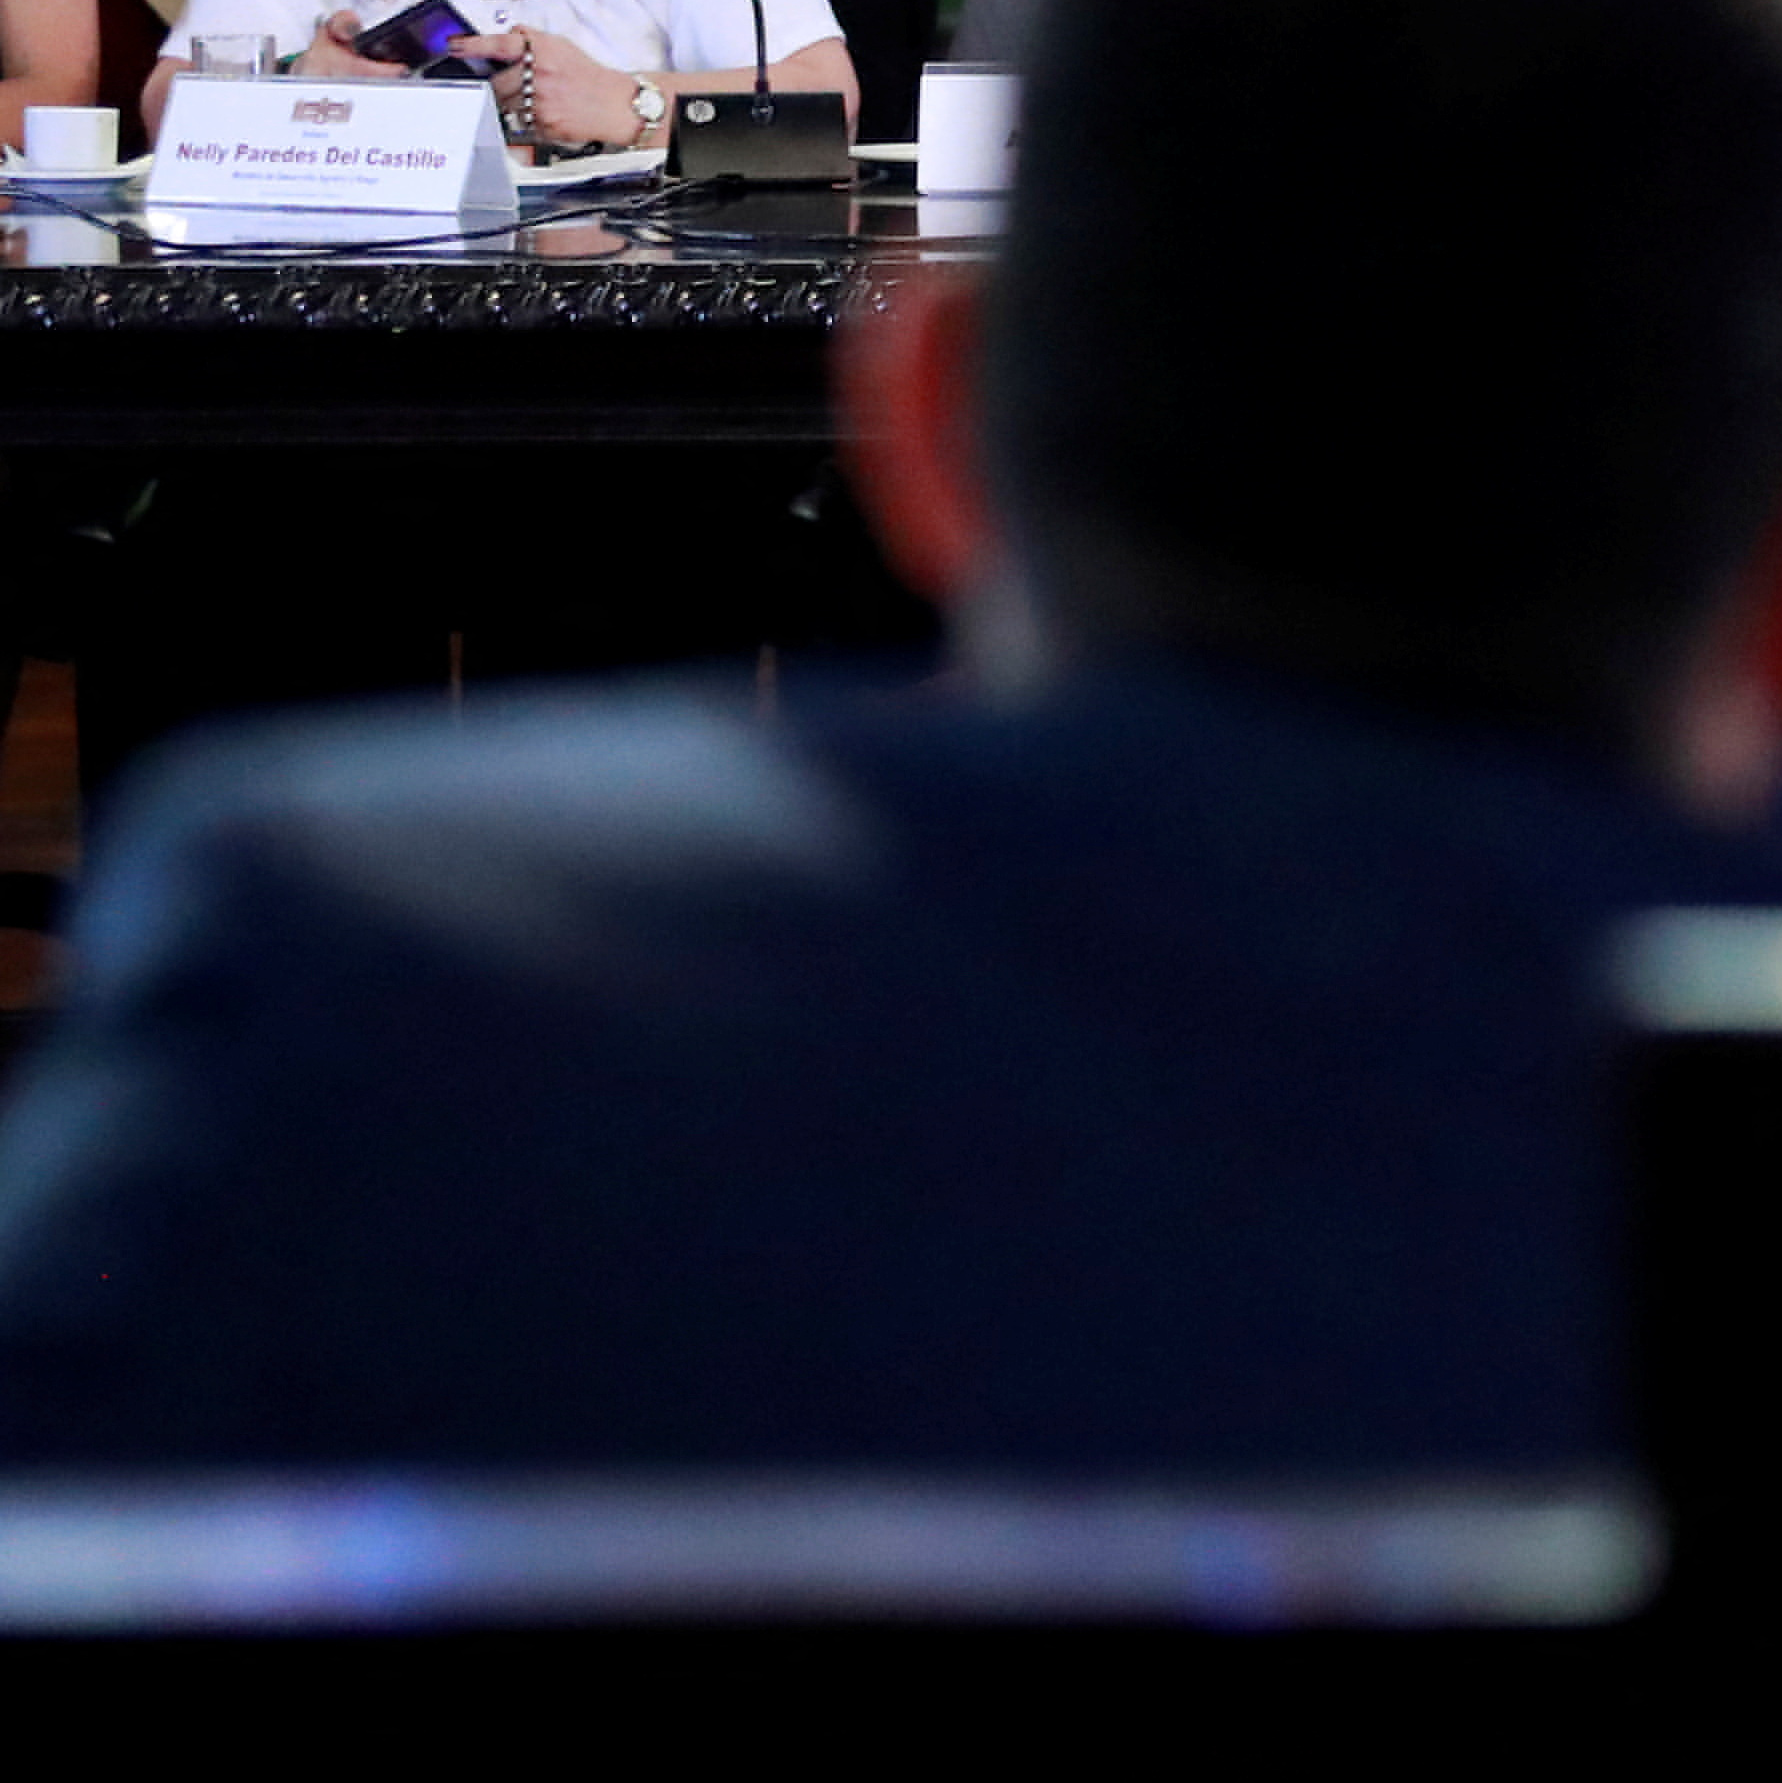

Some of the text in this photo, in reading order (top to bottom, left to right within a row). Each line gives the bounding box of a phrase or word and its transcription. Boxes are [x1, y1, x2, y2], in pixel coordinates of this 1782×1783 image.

[175, 142, 447, 169] Nelly Paredes Del Castillo
